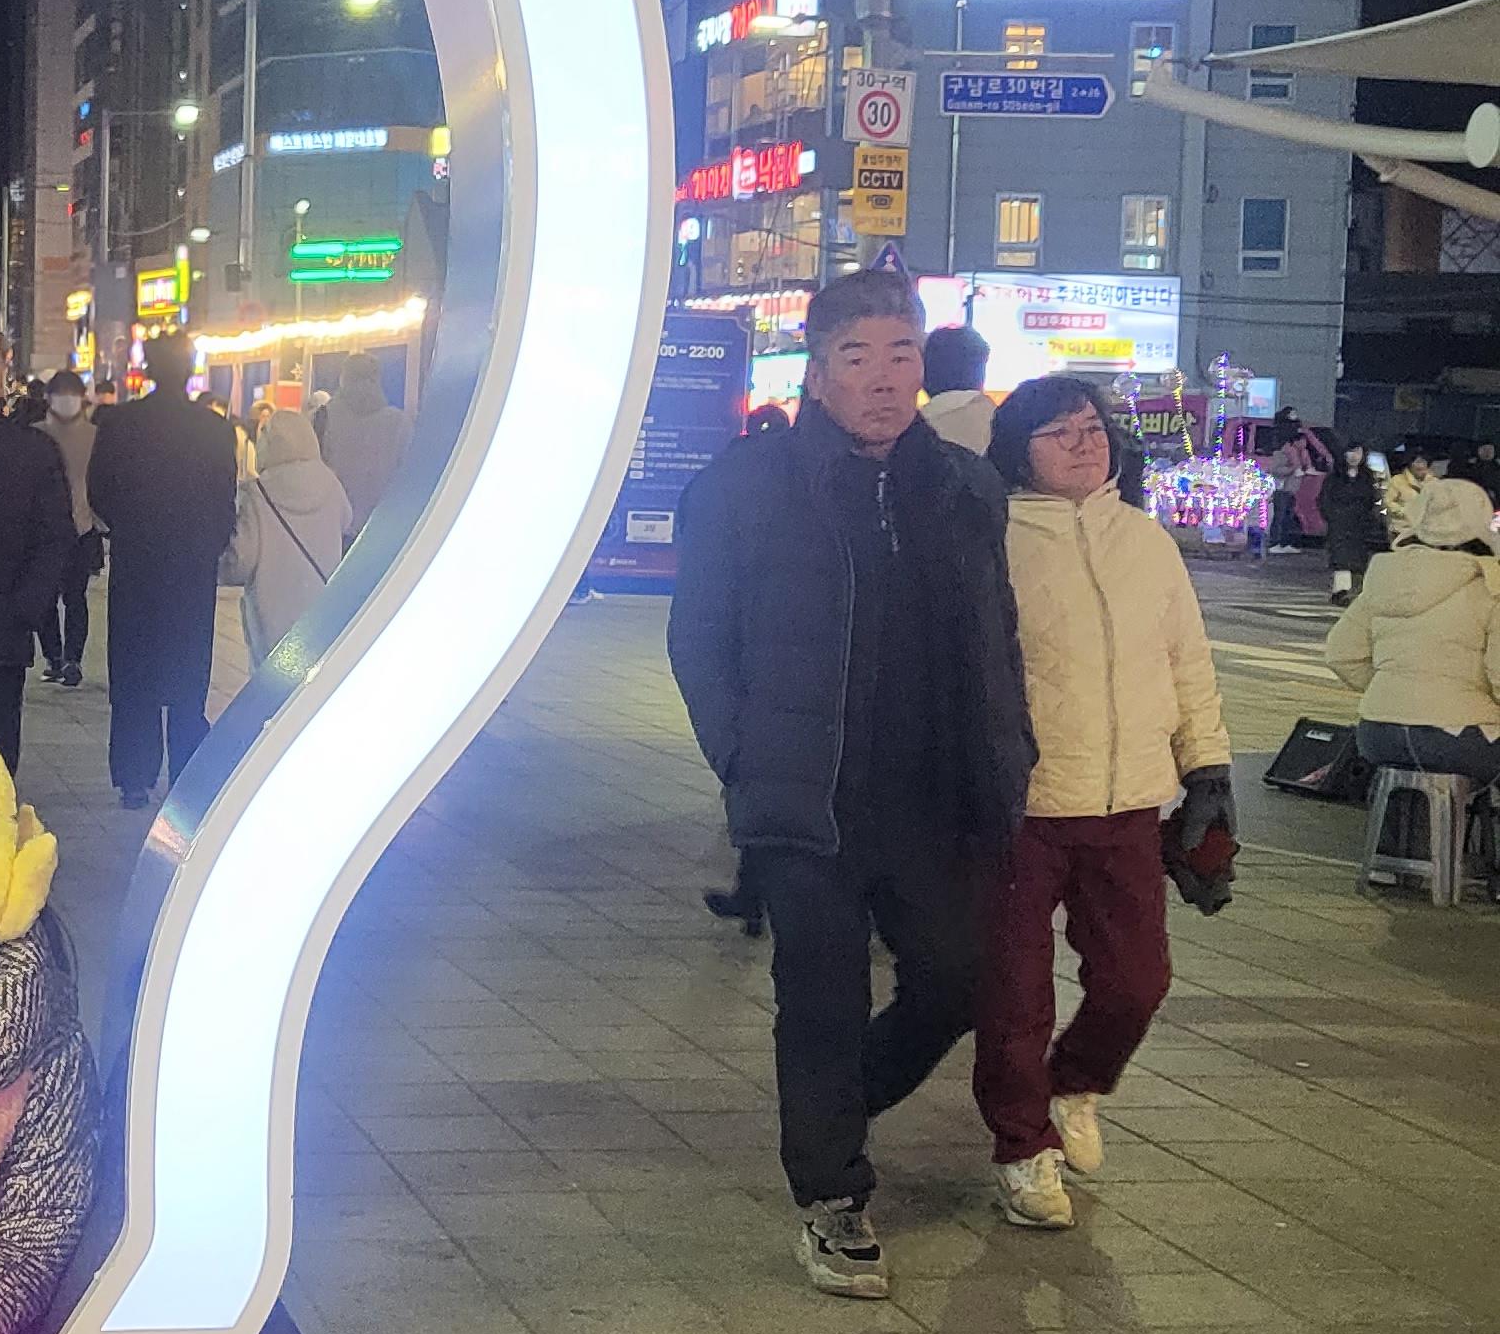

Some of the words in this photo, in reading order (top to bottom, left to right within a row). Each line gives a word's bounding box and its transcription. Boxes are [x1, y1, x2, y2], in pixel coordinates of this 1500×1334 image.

[856, 71, 907, 90] 30구역
[946, 77, 1065, 99] 구남로30번길
[867, 100, 891, 128] 30
[860, 171, 900, 187] CCTV
[689, 345, 725, 359] 22:00
